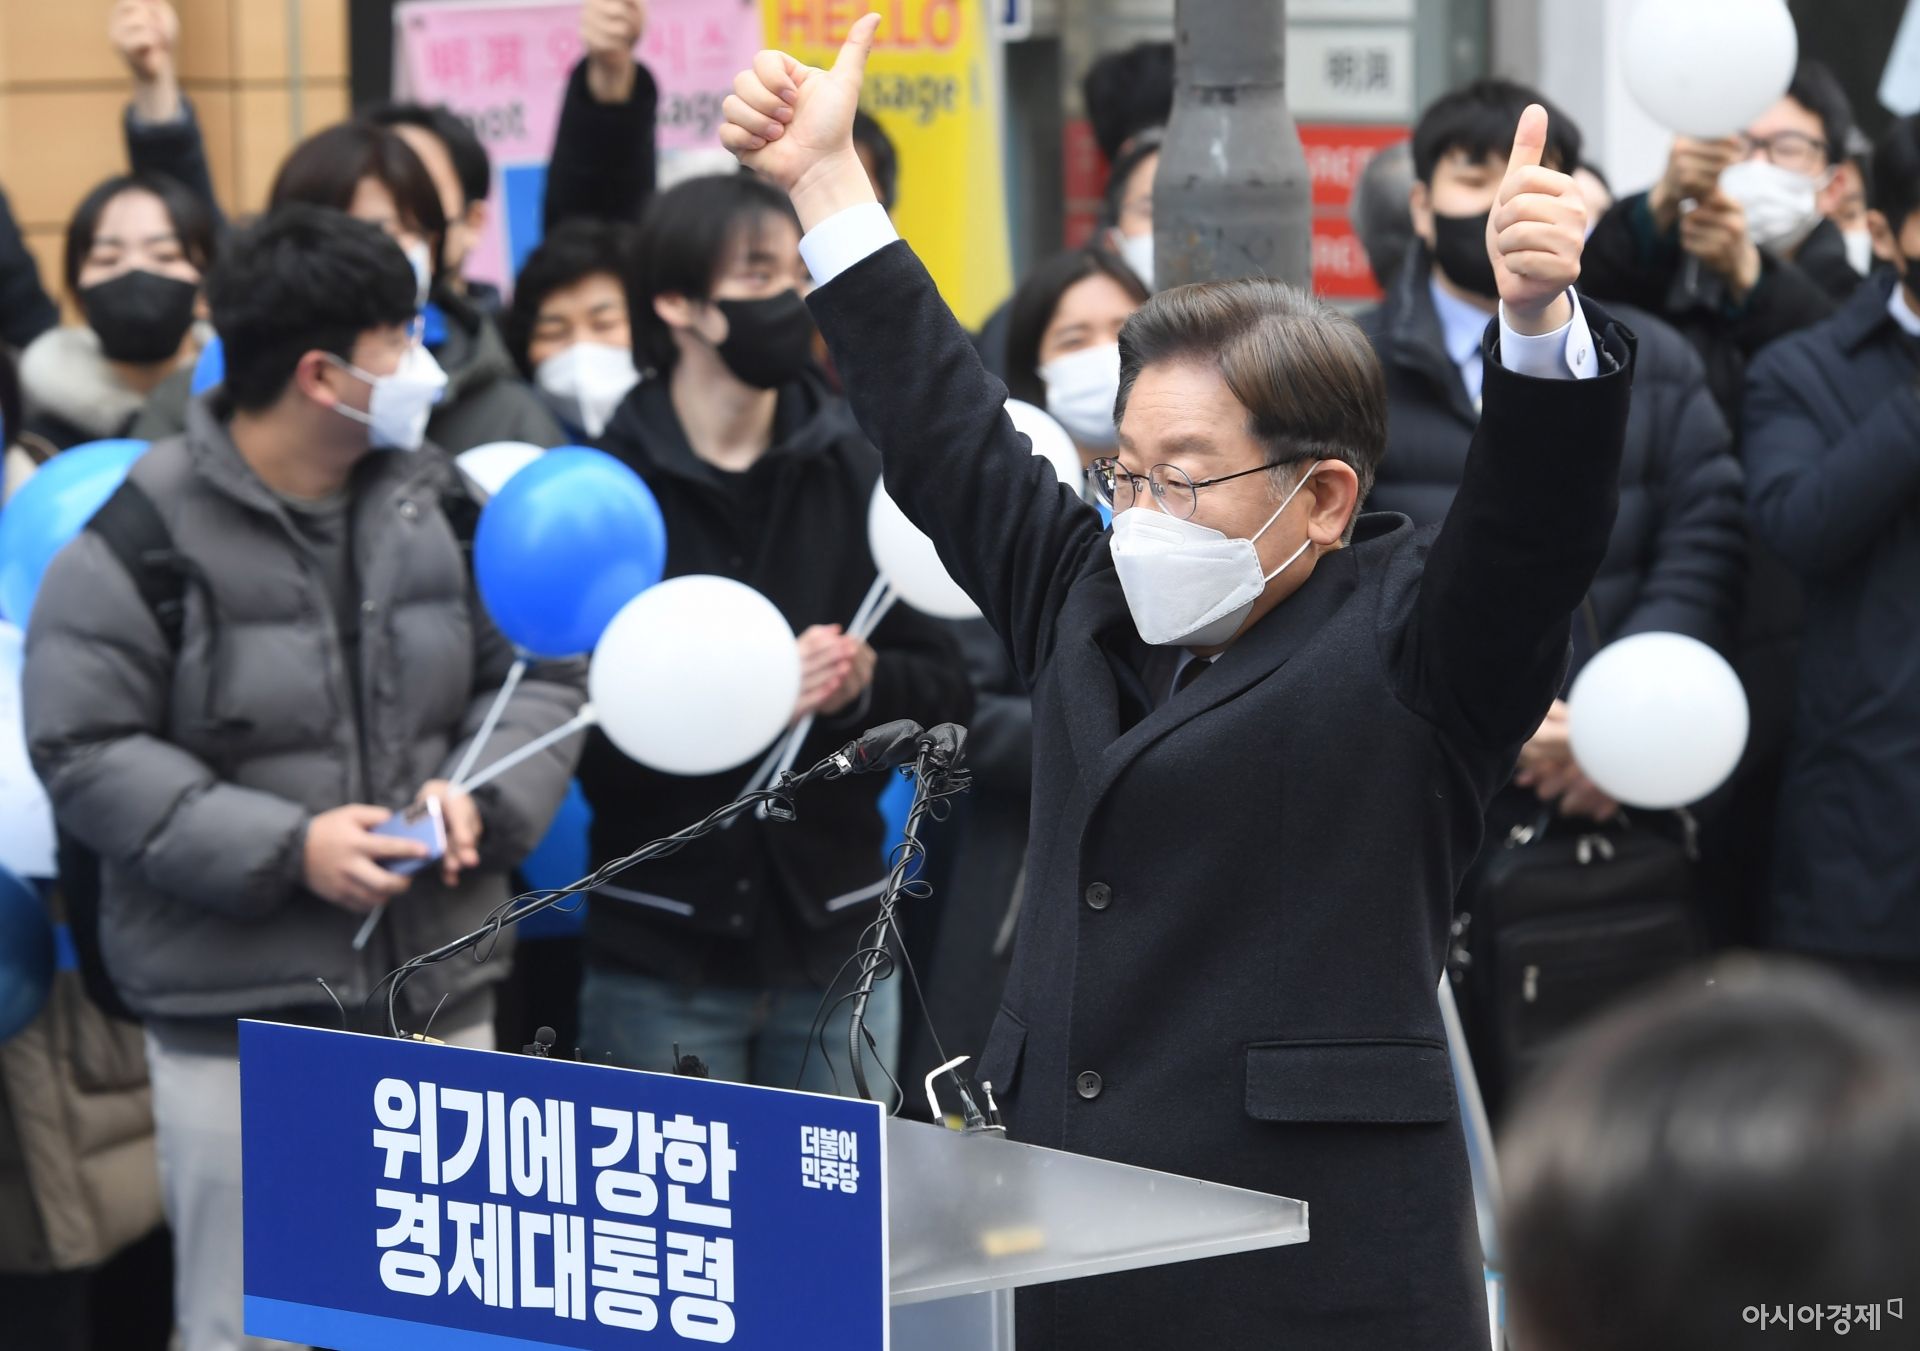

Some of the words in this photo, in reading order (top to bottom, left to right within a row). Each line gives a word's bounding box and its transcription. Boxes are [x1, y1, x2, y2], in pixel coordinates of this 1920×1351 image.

[373, 1077, 578, 1205] 위기에
[590, 1106, 738, 1229] 강한
[800, 1125, 858, 1163] 더불어
[801, 1156, 860, 1194] 민주당
[375, 1188, 736, 1344] 경제대통령
